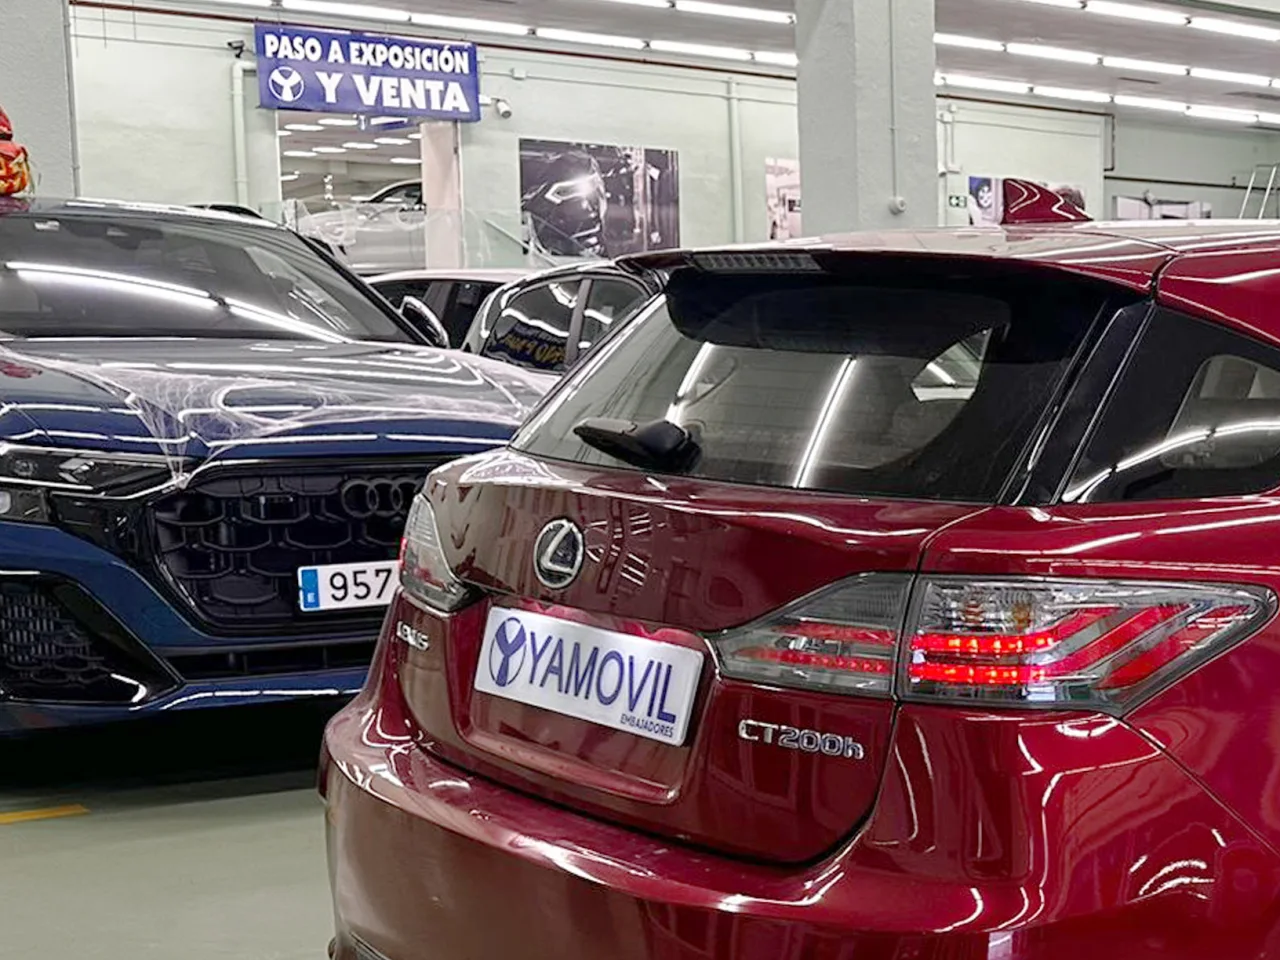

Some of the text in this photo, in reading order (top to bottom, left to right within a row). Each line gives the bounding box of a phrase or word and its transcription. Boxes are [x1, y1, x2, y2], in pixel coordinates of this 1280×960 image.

[264, 34, 470, 74] PASO A EXPOSICIÓN
[315, 71, 470, 112] Y VENTA
[329, 568, 392, 602] 957
[529, 631, 676, 724] YAMOVIL
[620, 713, 674, 738] EMBAJADORES
